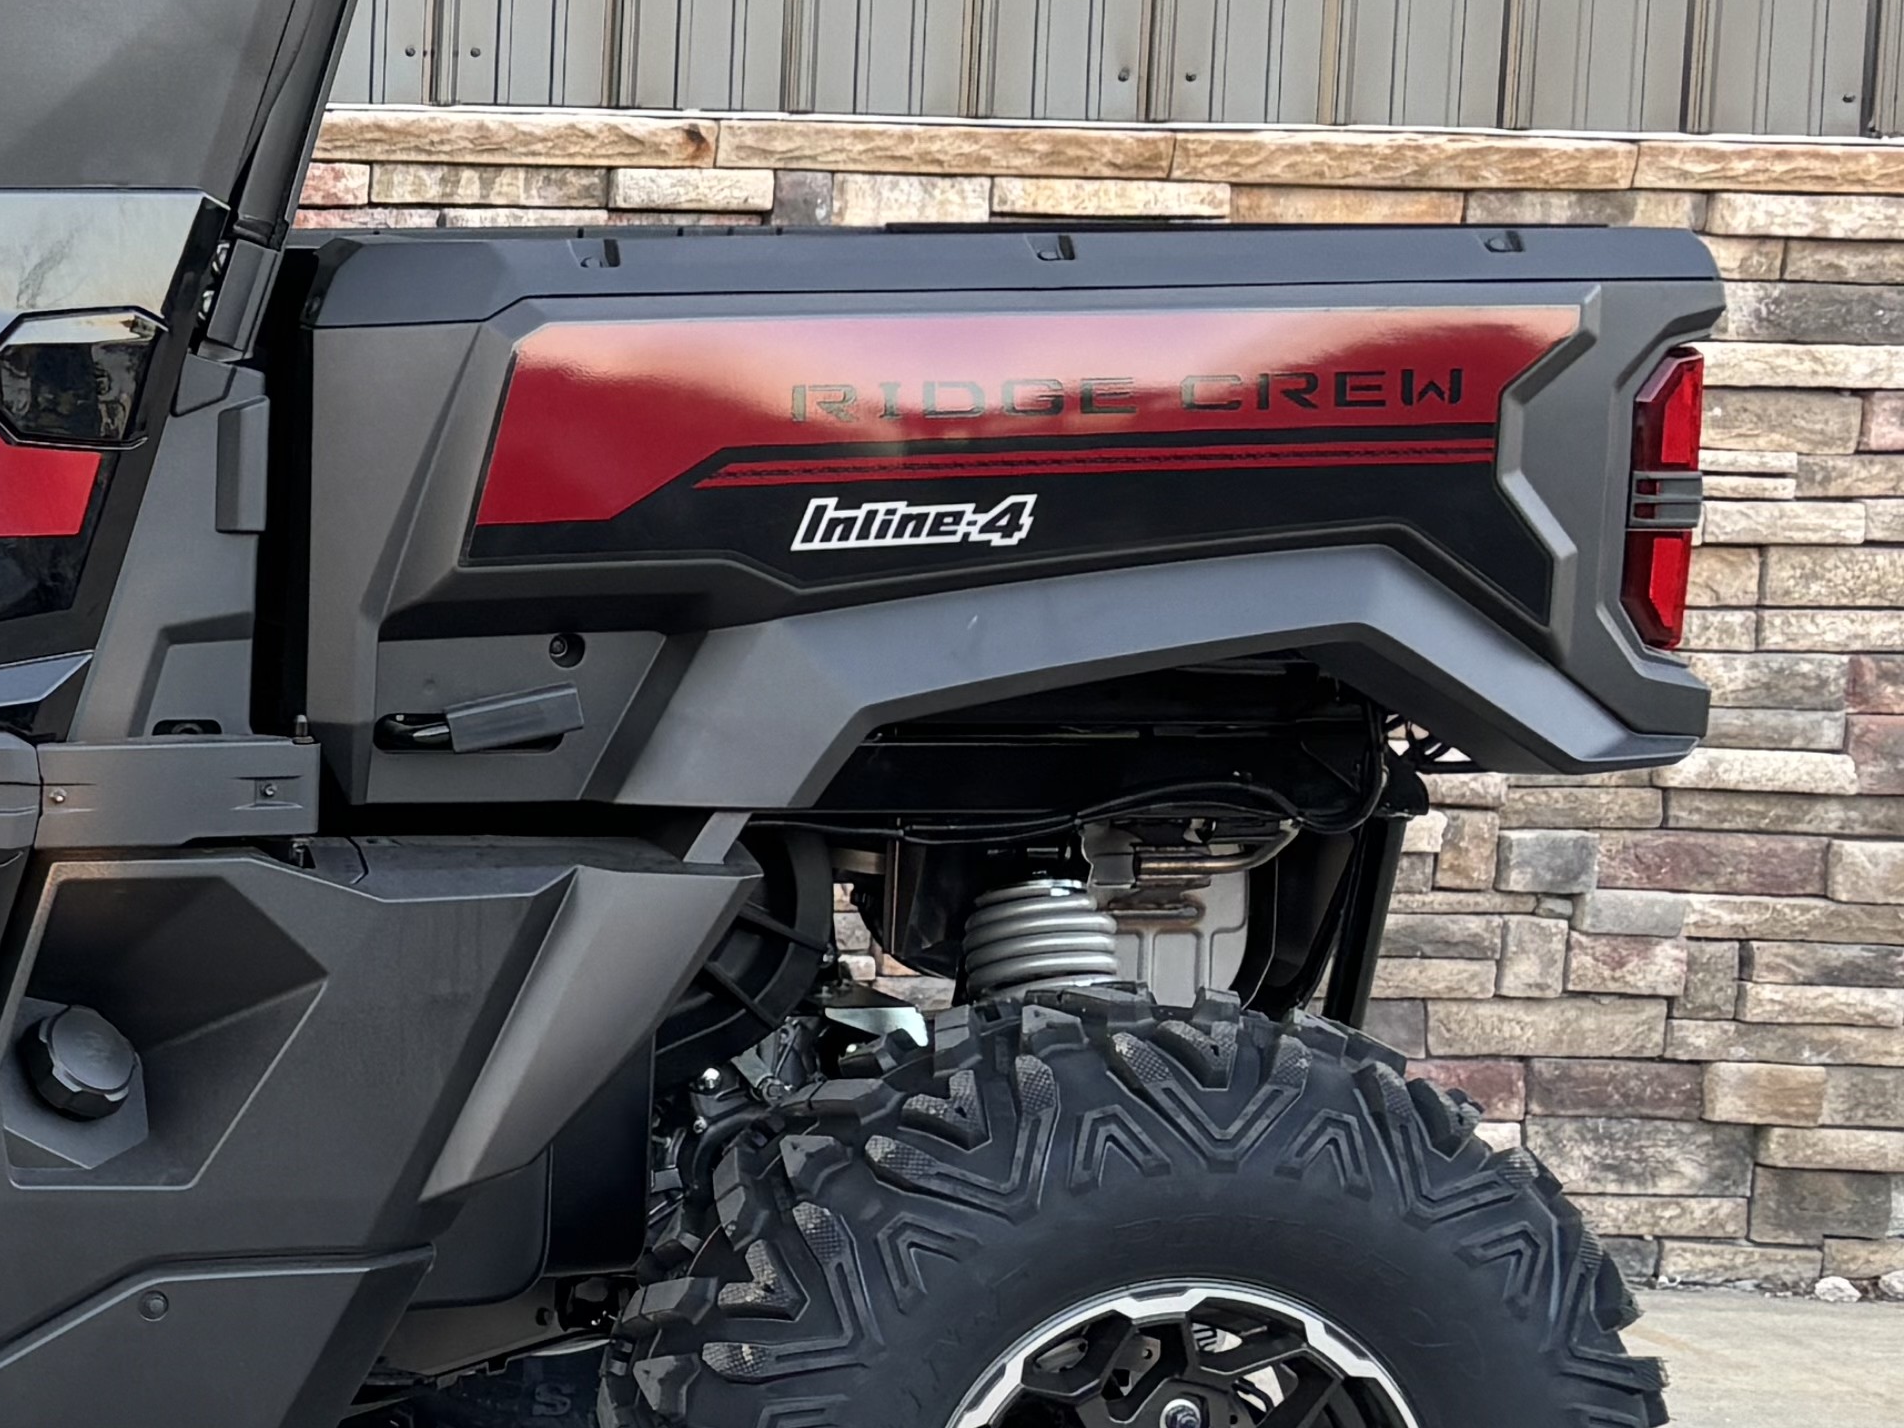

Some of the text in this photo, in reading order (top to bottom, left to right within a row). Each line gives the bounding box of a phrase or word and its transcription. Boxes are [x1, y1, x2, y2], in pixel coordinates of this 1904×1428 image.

[792, 368, 1462, 421] RIDGE CREW
[791, 494, 1038, 550] Inline-4
